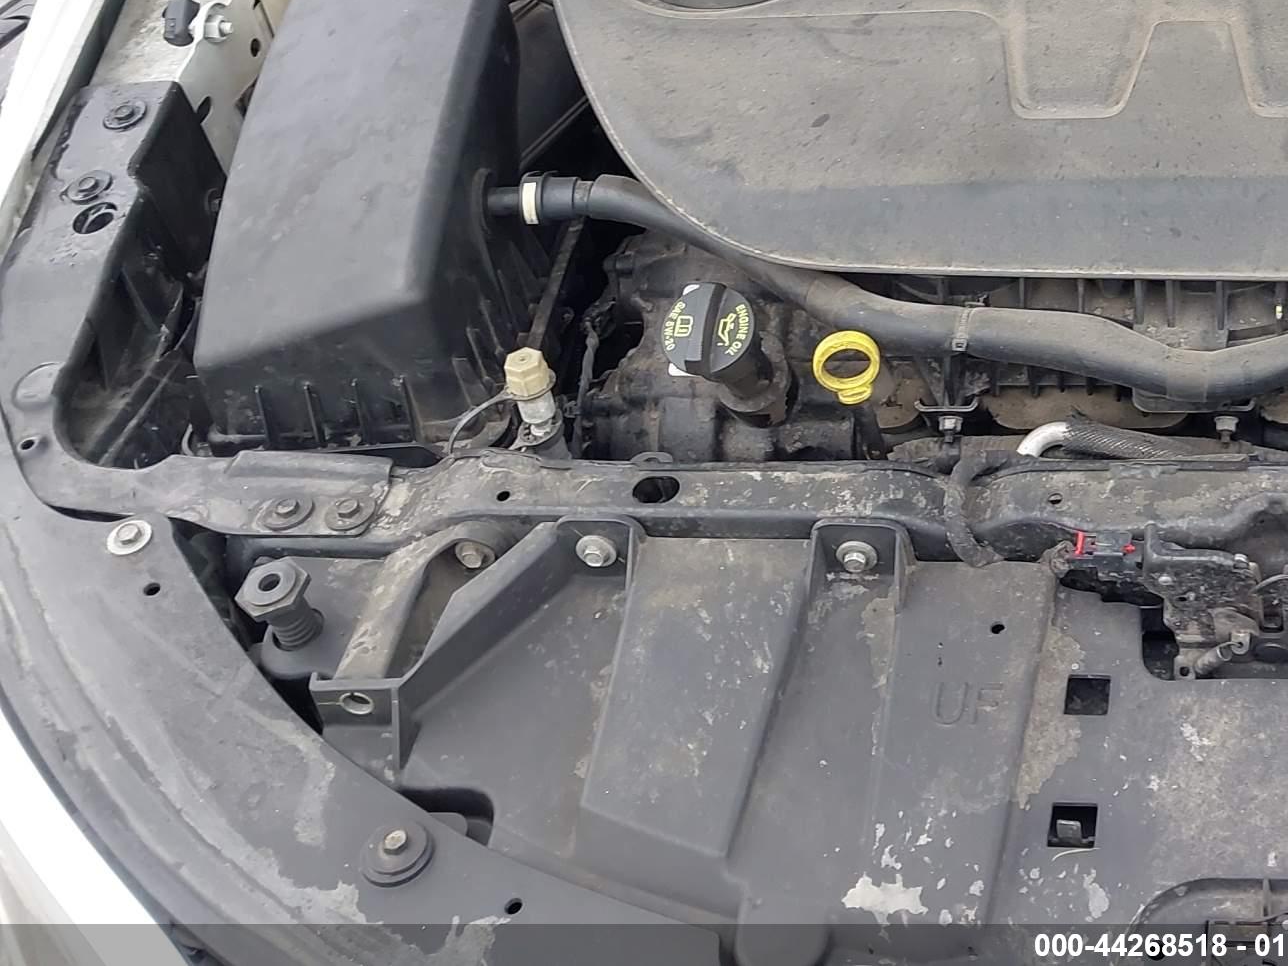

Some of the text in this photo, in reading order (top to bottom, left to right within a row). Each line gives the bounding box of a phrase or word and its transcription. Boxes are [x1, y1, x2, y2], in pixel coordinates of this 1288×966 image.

[668, 301, 686, 320] SAE
[724, 304, 749, 356] ENGINE OIL
